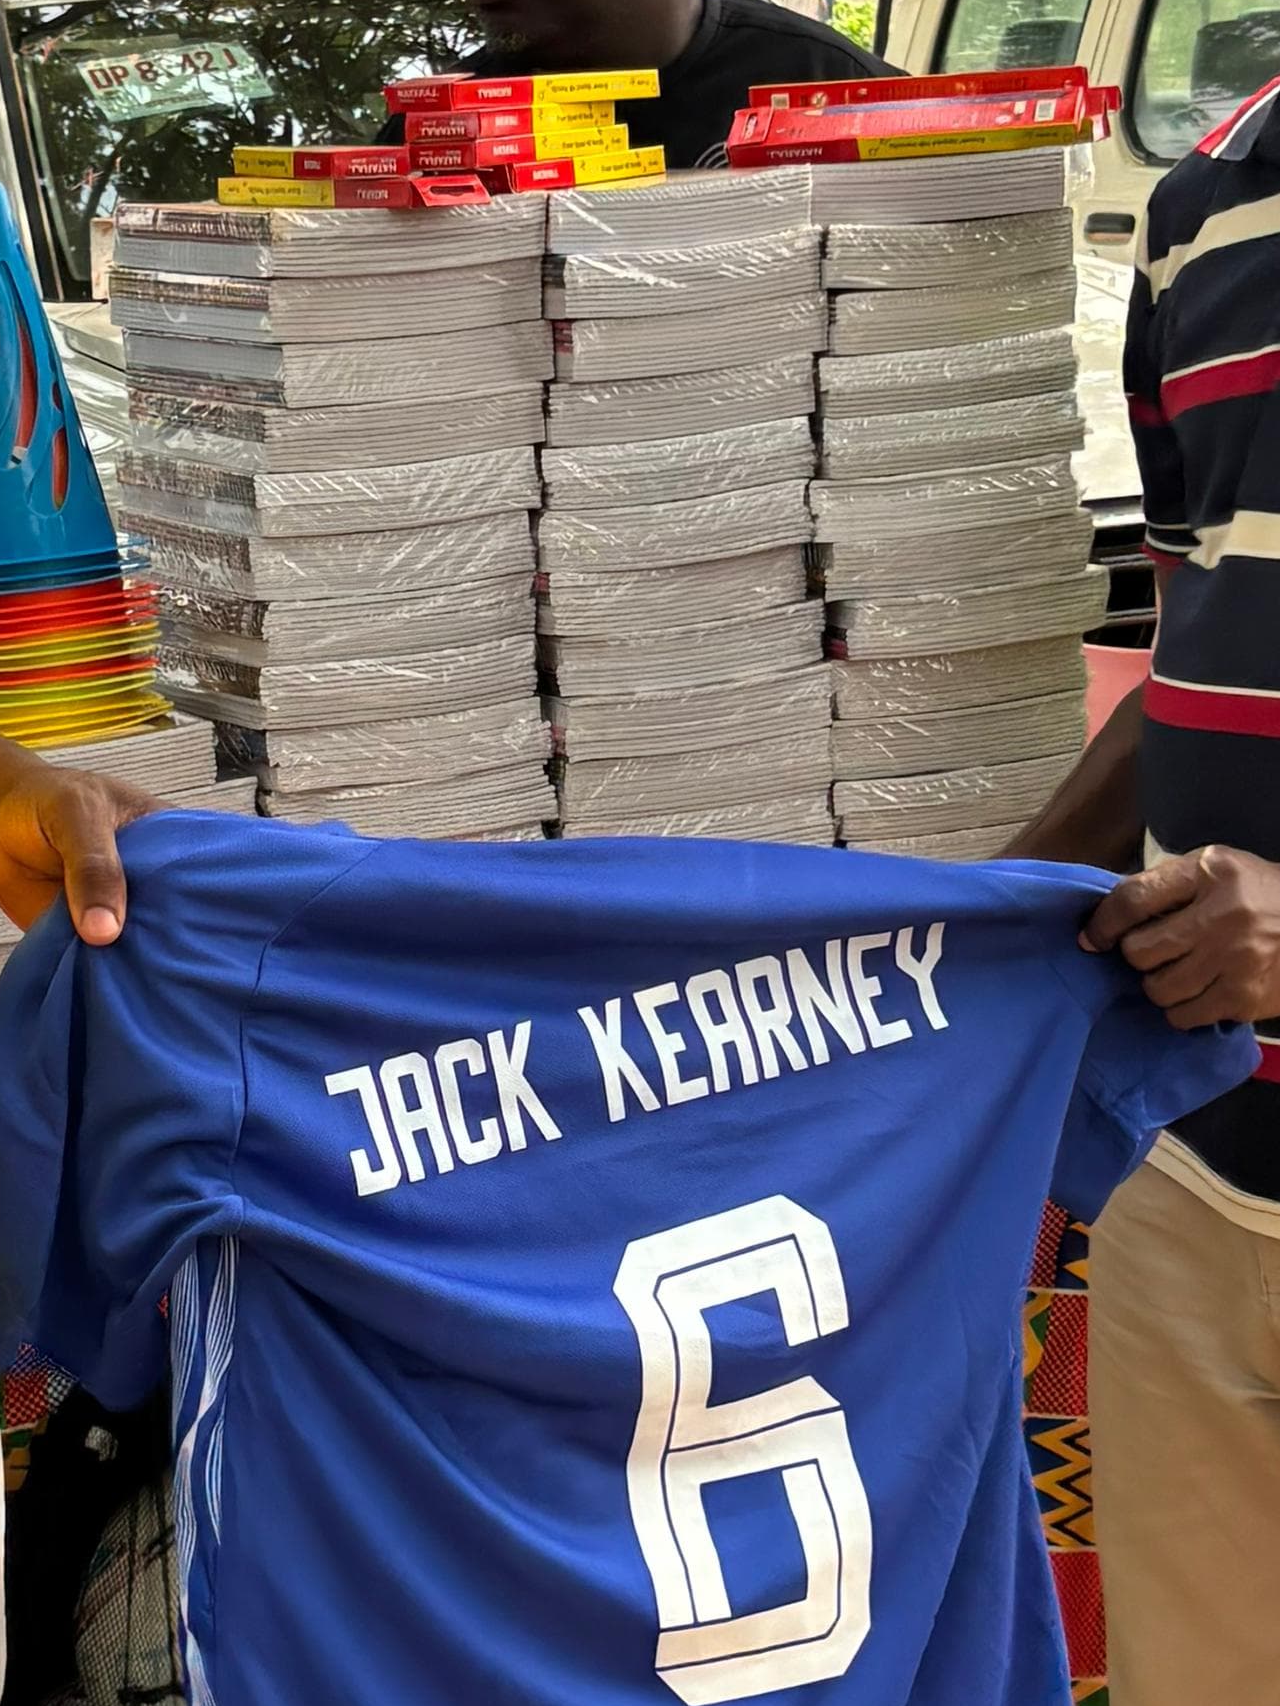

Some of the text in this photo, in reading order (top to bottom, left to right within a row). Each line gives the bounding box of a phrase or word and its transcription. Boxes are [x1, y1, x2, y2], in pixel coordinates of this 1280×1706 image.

[324, 921, 949, 1196] JACK KEARNEY
[612, 1194, 873, 1706] 6
